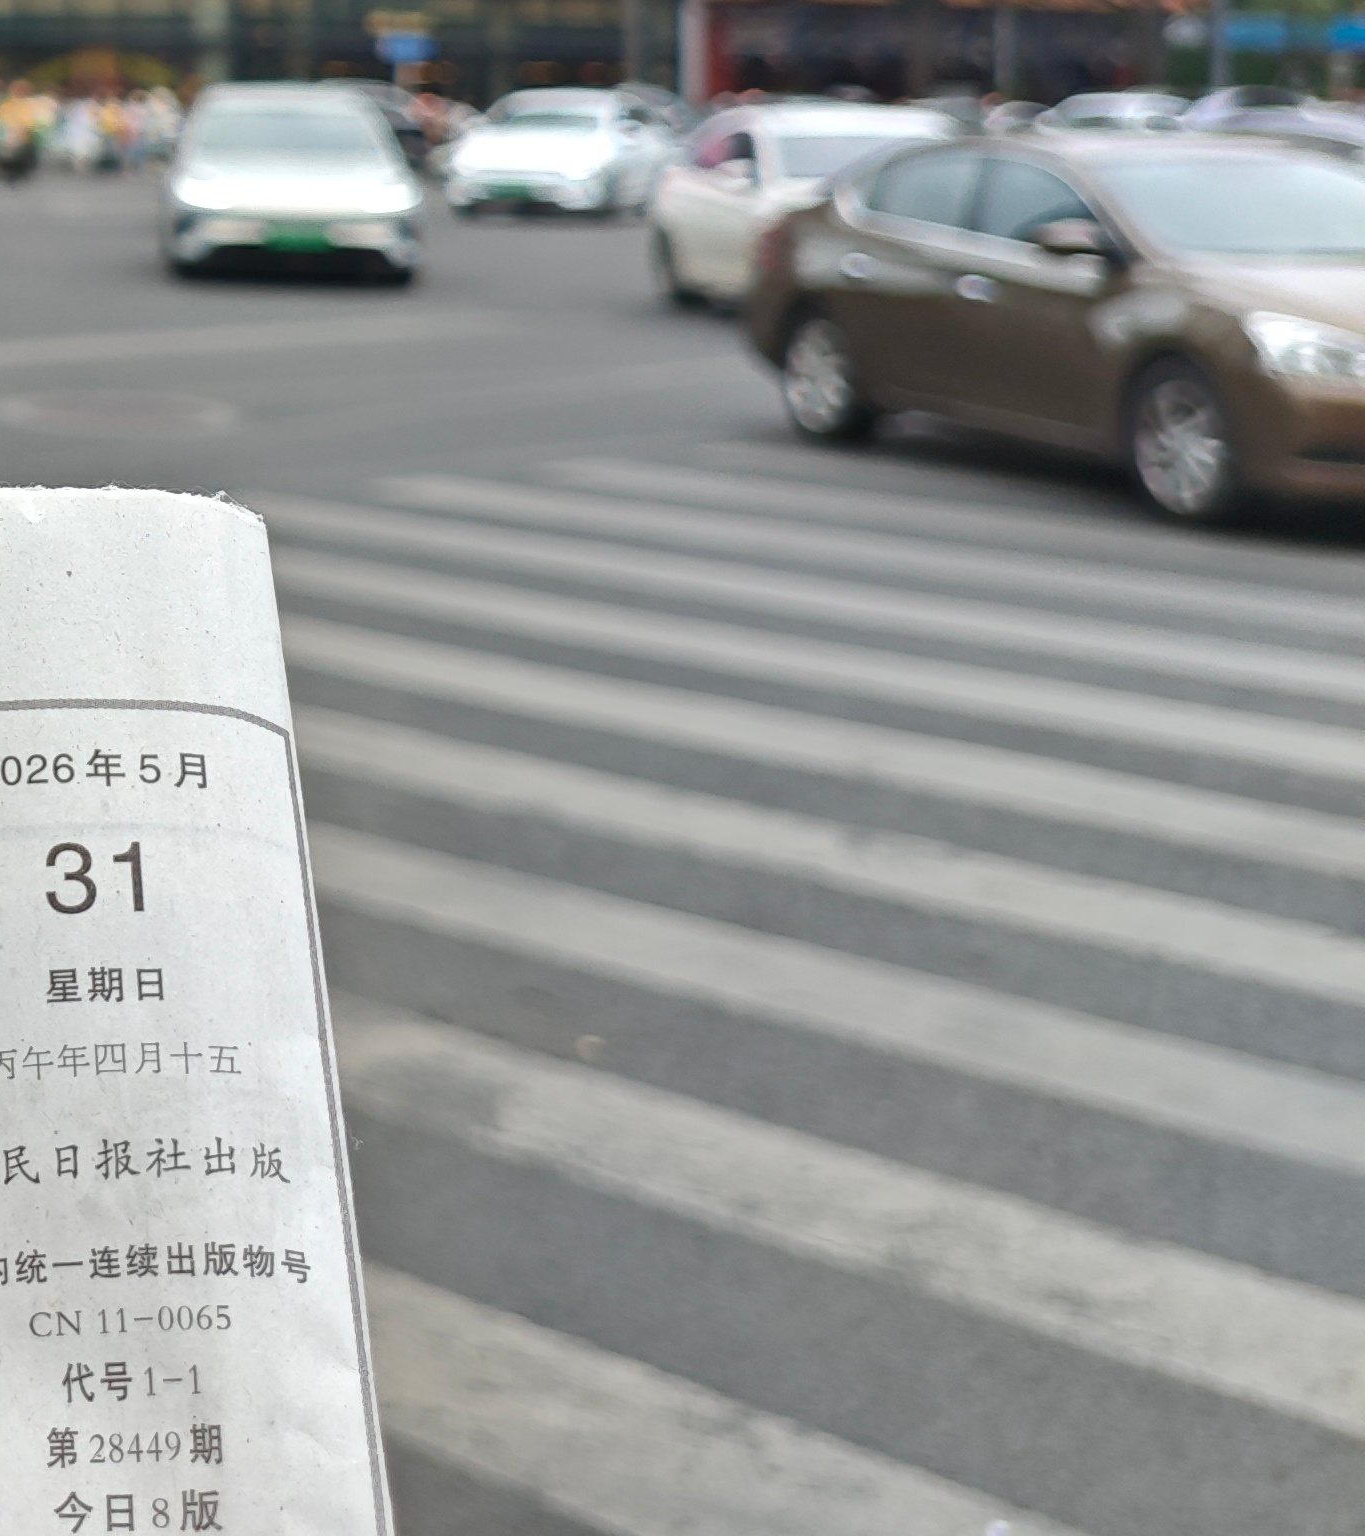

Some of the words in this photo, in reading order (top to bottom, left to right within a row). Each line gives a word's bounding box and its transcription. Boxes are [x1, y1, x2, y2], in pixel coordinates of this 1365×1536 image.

[46, 841, 145, 914] 31
[46, 966, 164, 1003] 星期日
[29, 1311, 81, 1337] CN
[98, 1305, 231, 1334] 11-0065
[47, 1423, 223, 1468] 第28449期
[54, 1489, 223, 1534] 今日8版
